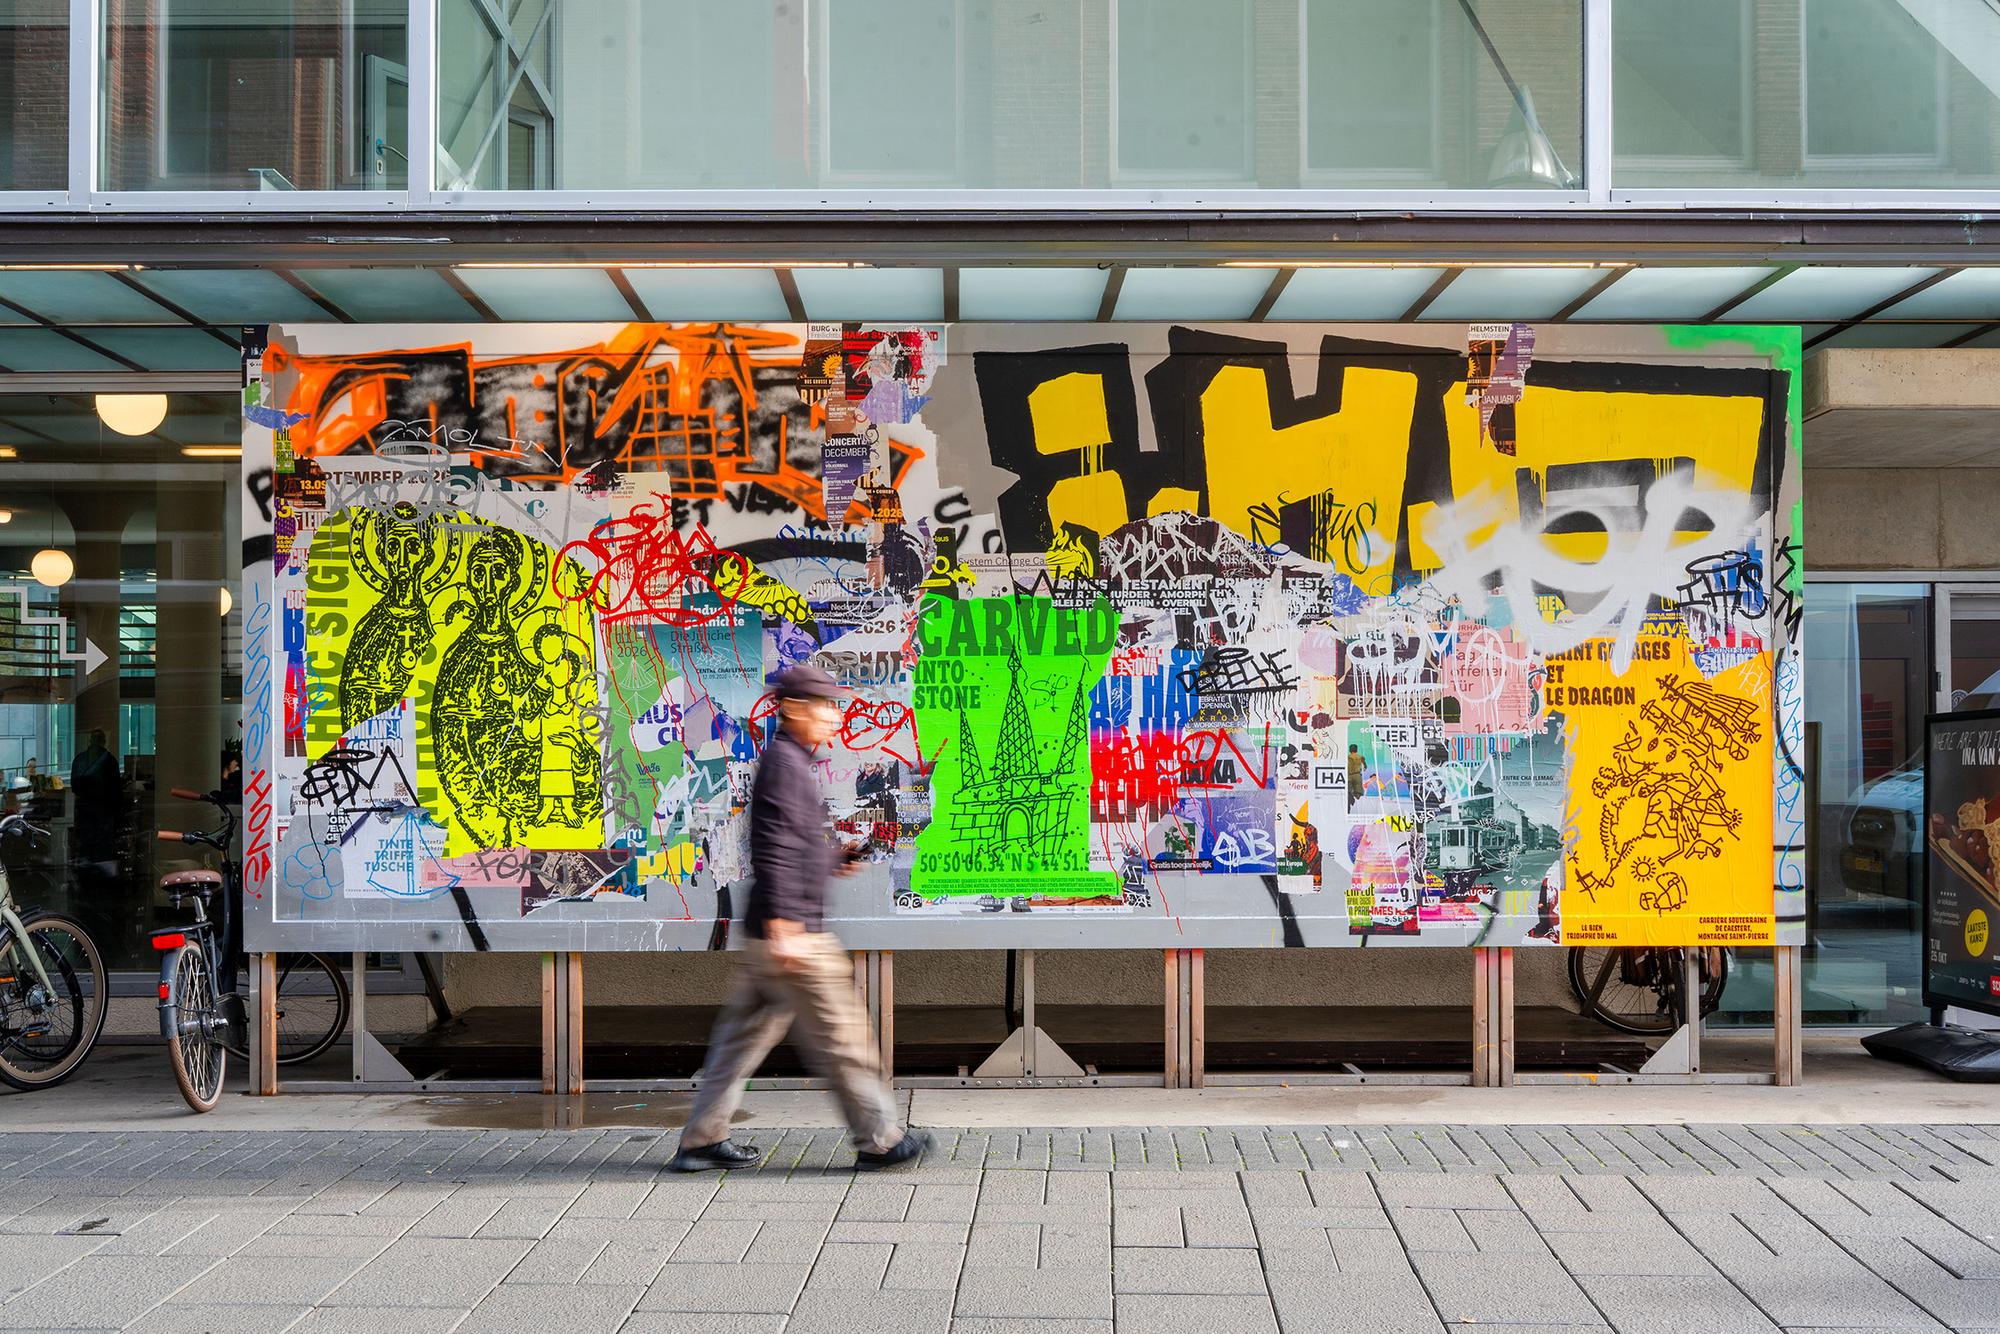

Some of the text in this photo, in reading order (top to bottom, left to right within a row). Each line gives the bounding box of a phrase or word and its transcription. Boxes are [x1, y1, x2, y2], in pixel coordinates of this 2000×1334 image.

[825, 447, 868, 458] DECEMBER
[958, 556, 989, 568] System
[995, 556, 1031, 567] Change
[1117, 599, 1154, 607] WITHIN
[918, 598, 1118, 657] CARVED
[617, 646, 647, 658] 2026
[1598, 641, 1671, 660] GRGES
[914, 660, 964, 684] INTO
[1546, 664, 1564, 682] ET
[914, 685, 981, 710] STONE
[1546, 687, 1564, 705] LE
[1568, 687, 1636, 706] DRAGON
[1979, 747, 1995, 766] VAN
[378, 839, 413, 849] TINTE
[374, 850, 413, 861] TRIFFT
[364, 861, 413, 872] TUSCHE
[1728, 916, 1767, 924] SOUTERRAINE
[1967, 921, 1987, 933] LAATSTE
[1566, 932, 1617, 940] TRIOMPHE DU MAL
[1698, 932, 1769, 940] MONTAGNE SAINT-PIERRE
